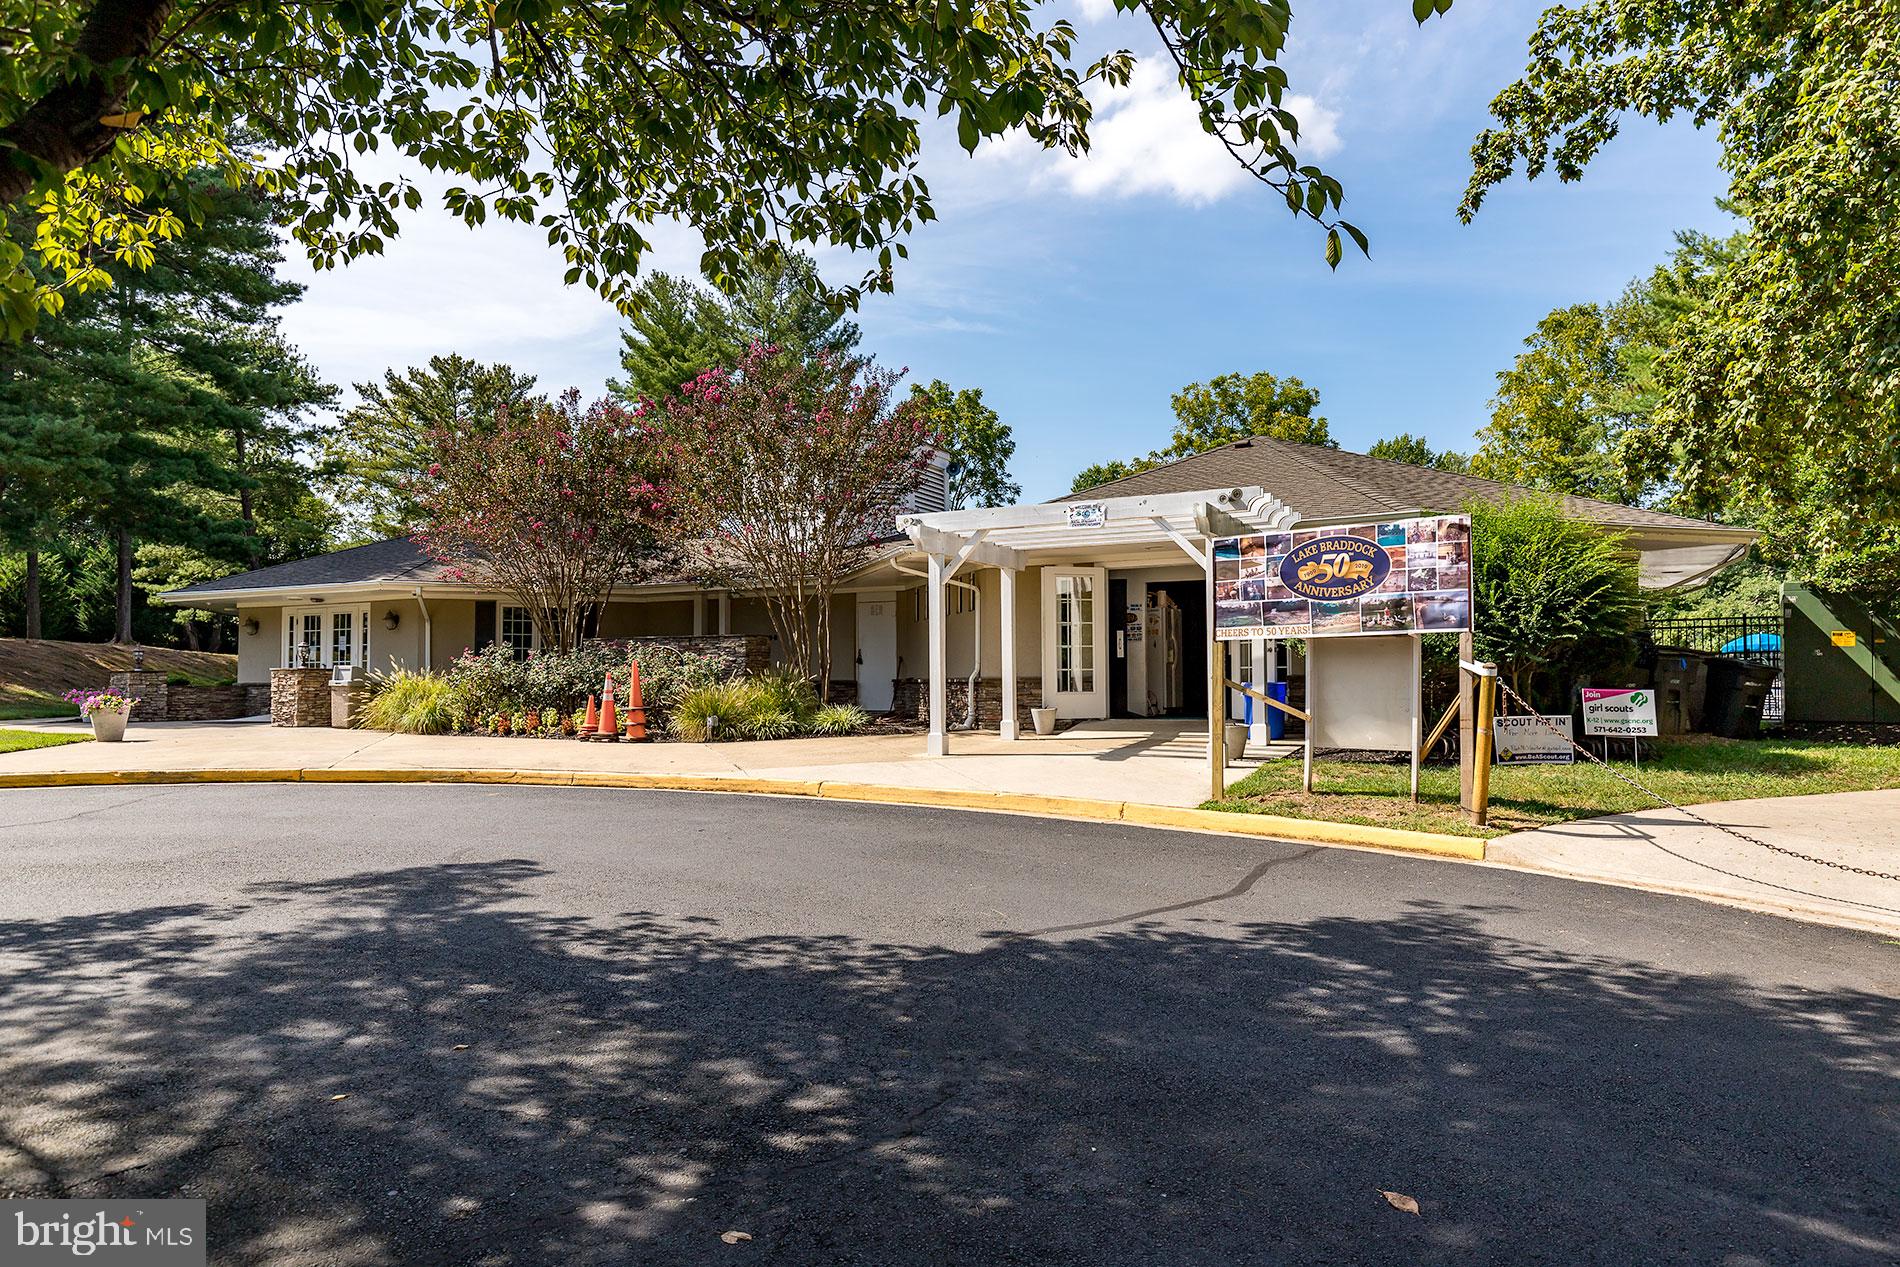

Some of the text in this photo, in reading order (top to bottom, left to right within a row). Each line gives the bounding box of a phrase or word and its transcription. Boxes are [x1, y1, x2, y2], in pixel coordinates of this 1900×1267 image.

[1292, 540, 1378, 563] LAKE BRADDOCK
[1314, 552, 1351, 584] 50
[1294, 575, 1375, 598] ANNIVERSARY
[1215, 625, 1311, 638] CHEERS TO 50 YEARS!
[1585, 690, 1600, 698] Join
[1588, 703, 1634, 714] girl scouts
[1555, 717, 1566, 726] IN
[1593, 726, 1647, 734] 571-642-0253
